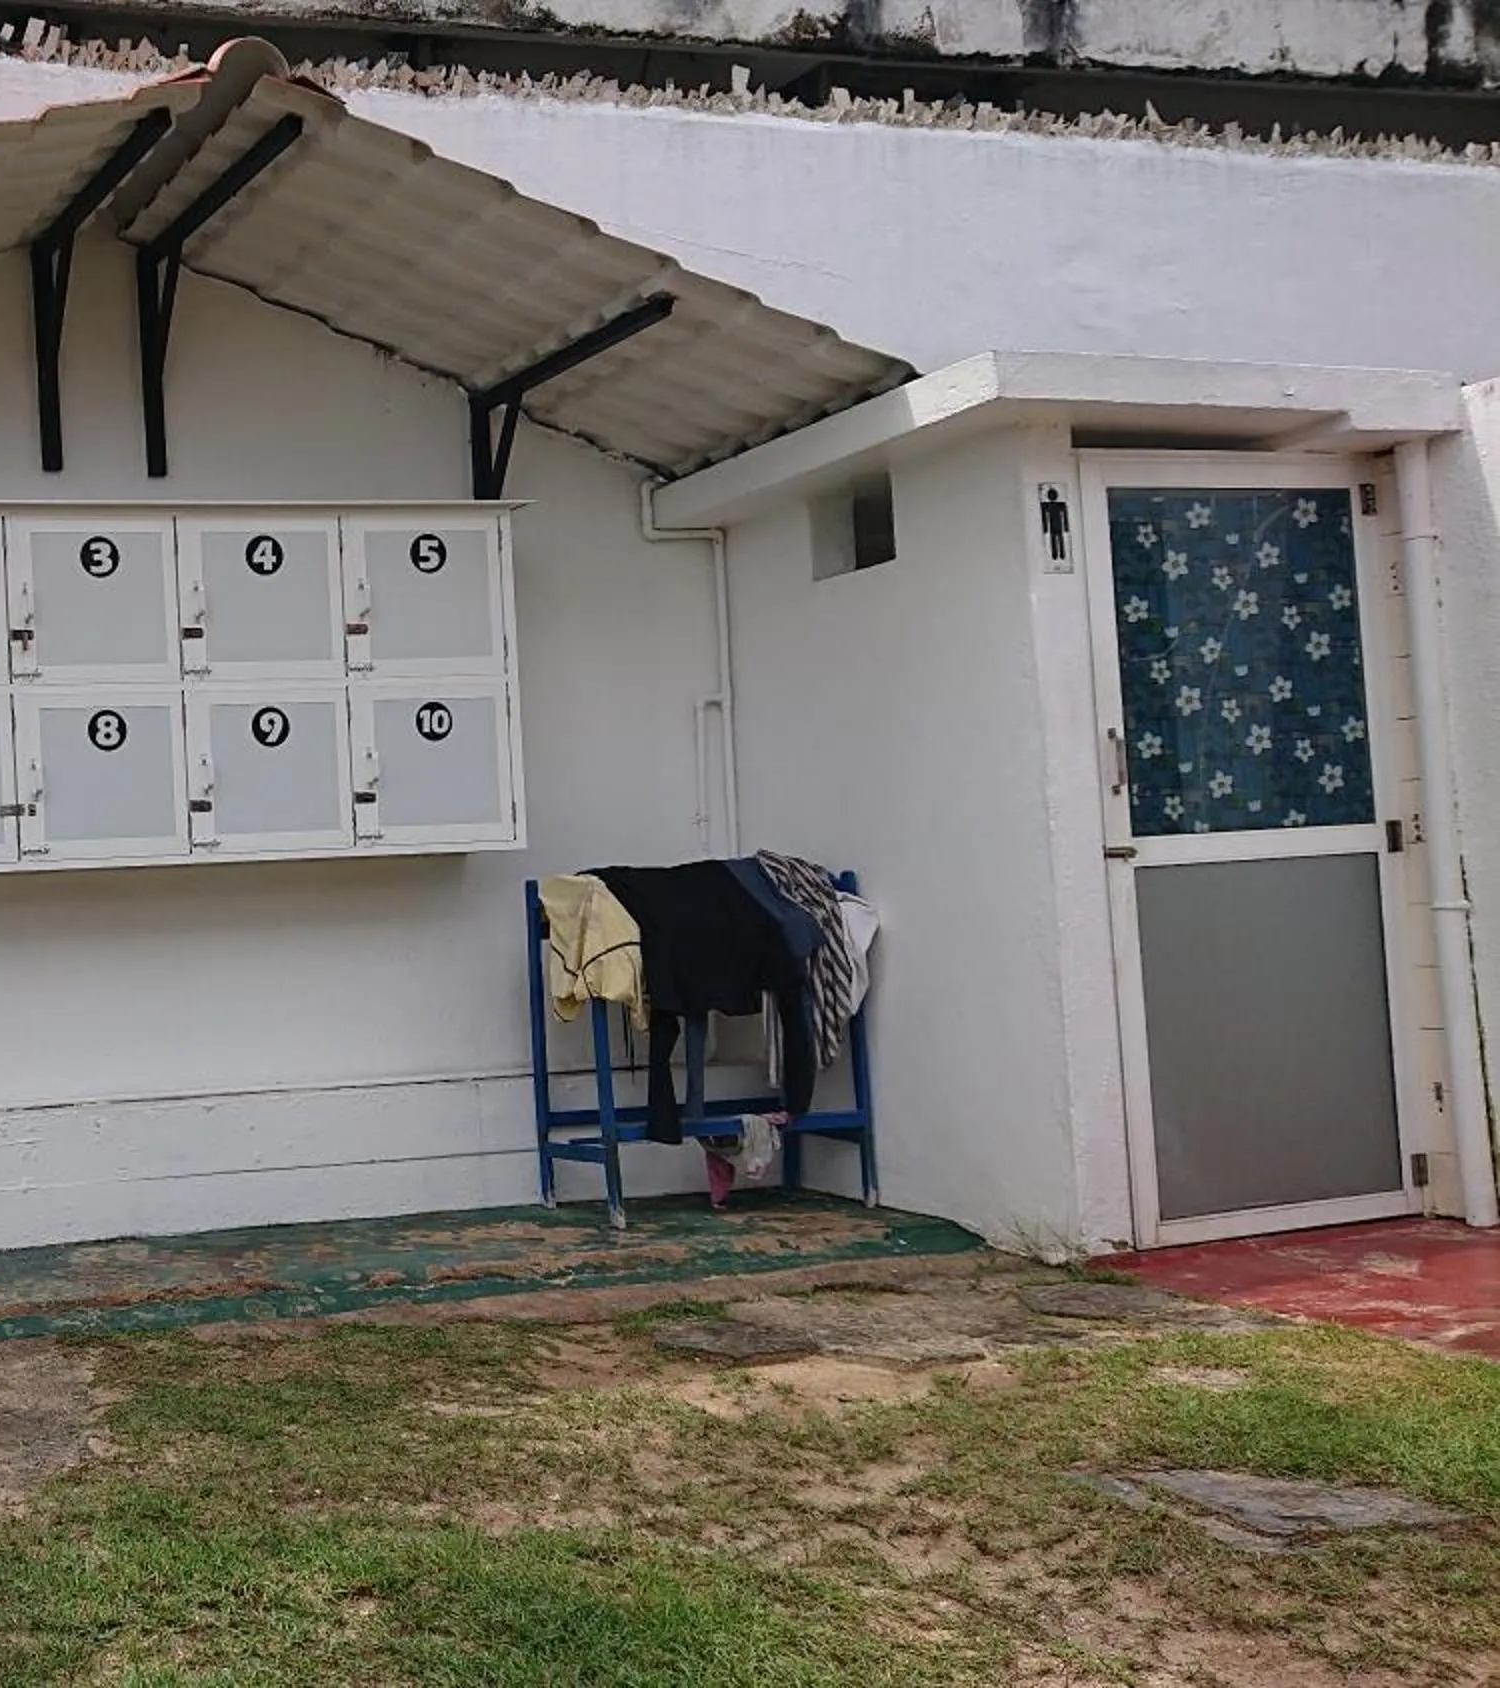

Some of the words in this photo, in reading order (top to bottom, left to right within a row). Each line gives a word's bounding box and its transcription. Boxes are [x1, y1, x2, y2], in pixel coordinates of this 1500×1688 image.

[89, 542, 113, 574] 3
[252, 540, 277, 571] 4
[418, 539, 440, 570] 5
[95, 714, 121, 746] 8
[259, 711, 283, 743] 9
[419, 709, 450, 734] 10
